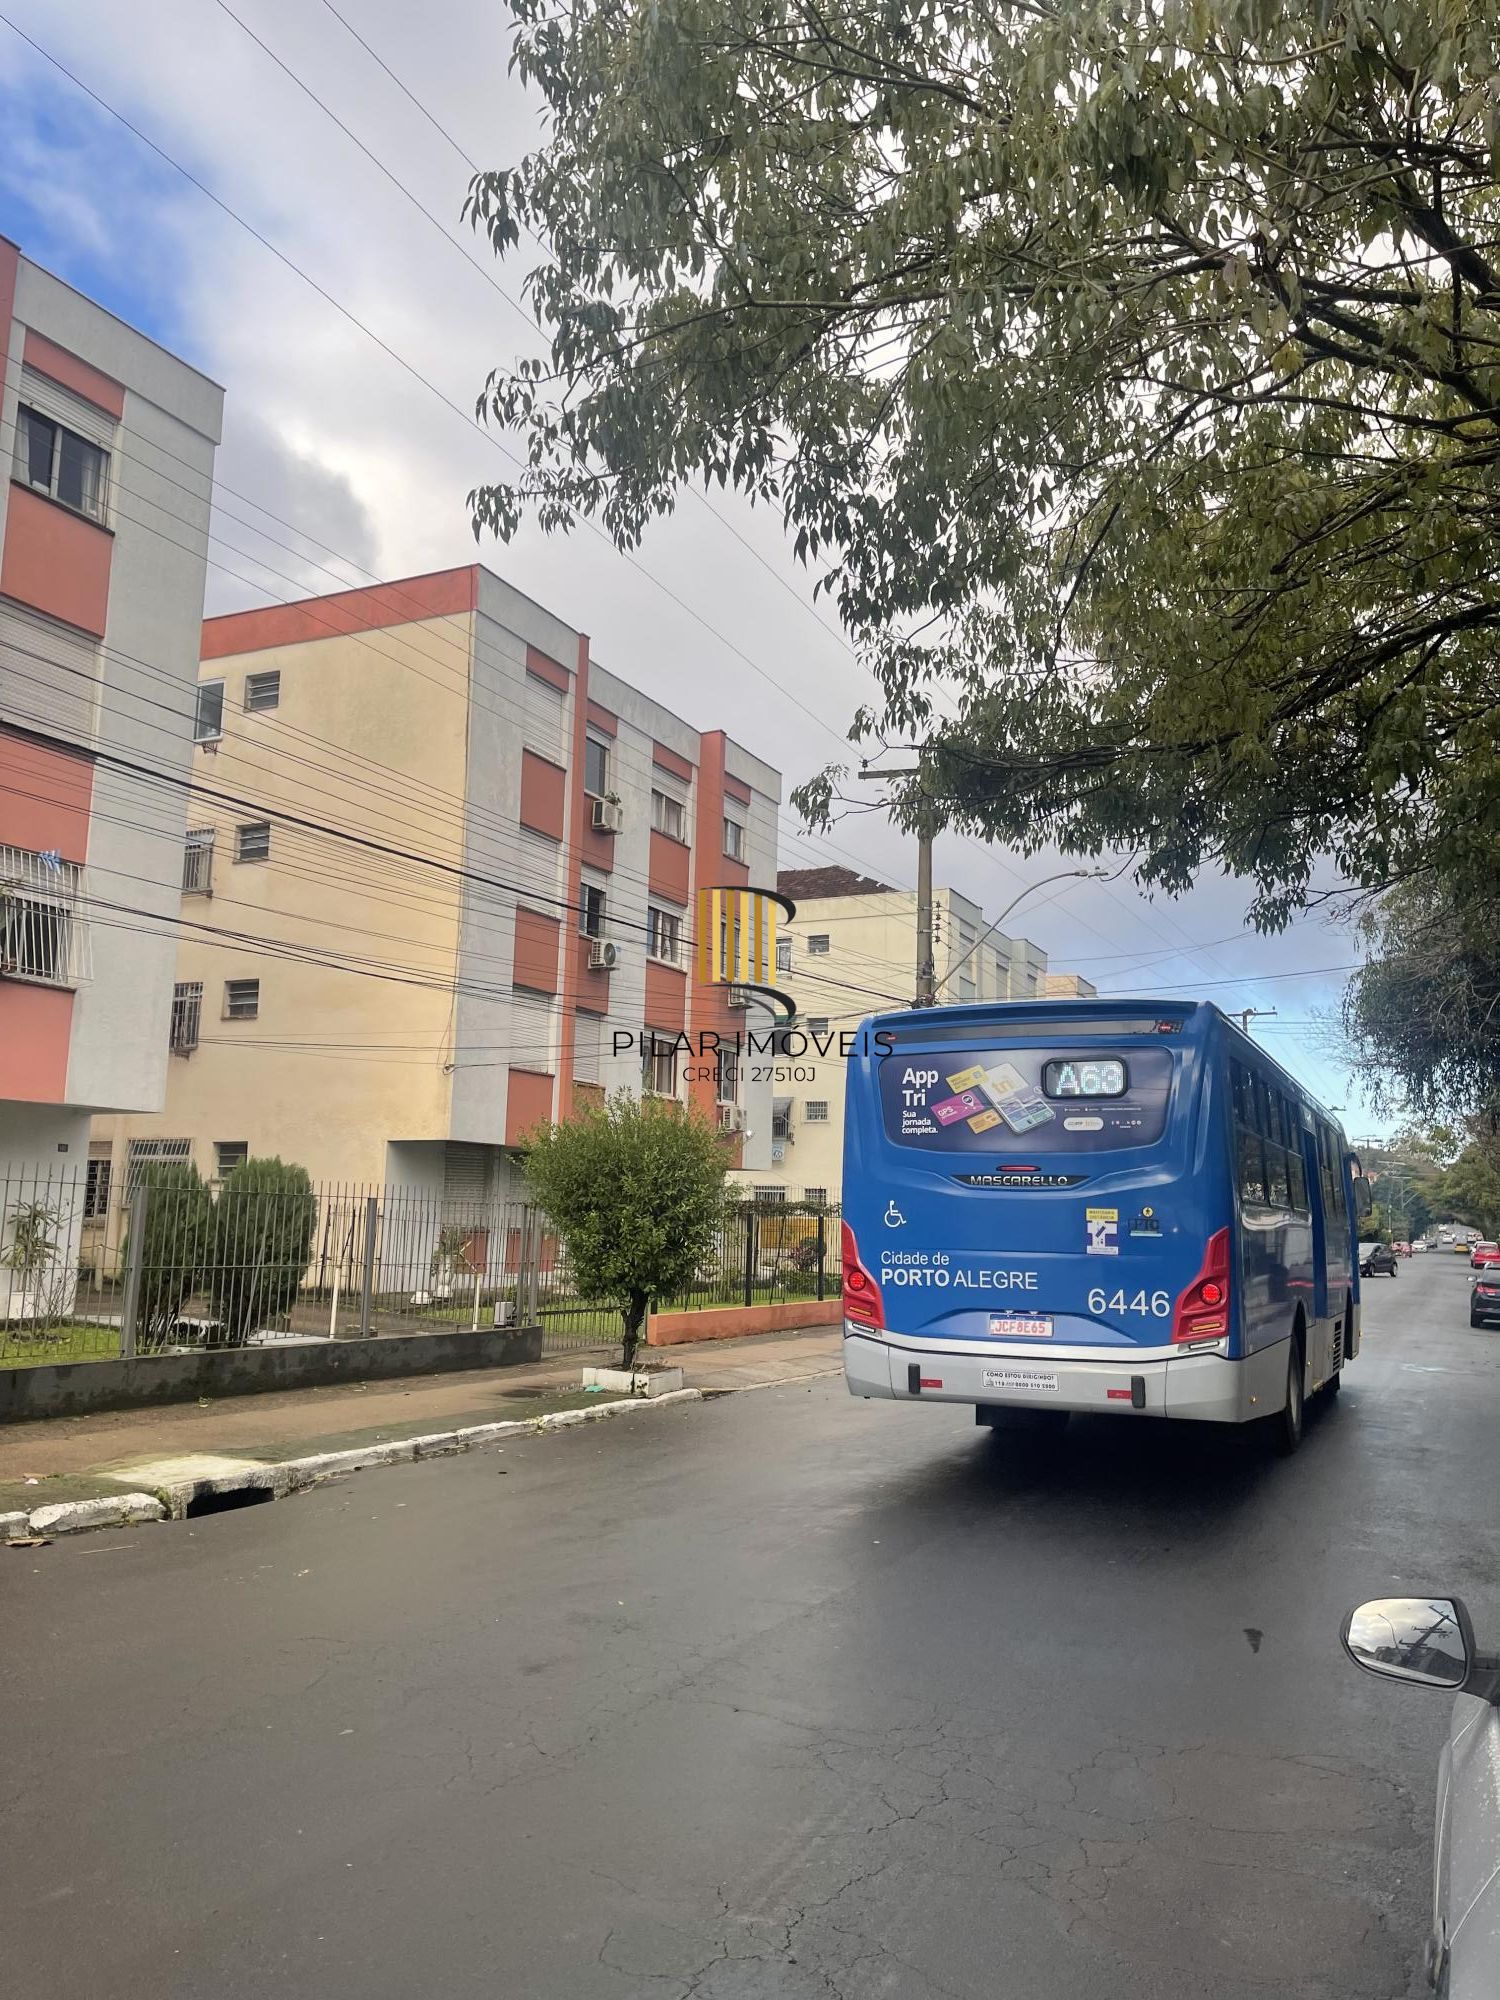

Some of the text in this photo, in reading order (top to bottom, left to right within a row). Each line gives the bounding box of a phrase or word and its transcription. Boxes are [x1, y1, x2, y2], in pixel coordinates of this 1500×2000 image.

[902, 1067, 939, 1088] App
[1056, 1064, 1123, 1095] A63
[902, 1089, 926, 1106] Tri
[902, 1110, 917, 1118] Sua
[901, 1118, 931, 1127] jornada
[901, 1126, 938, 1136] completa.
[970, 1175, 1068, 1186] MASCARELLO
[881, 1251, 950, 1266] Cidade de
[881, 1268, 1039, 1290] PORTO ALEGRE
[1087, 1288, 1170, 1318] 6446
[995, 1321, 1046, 1334] JCF8E65
